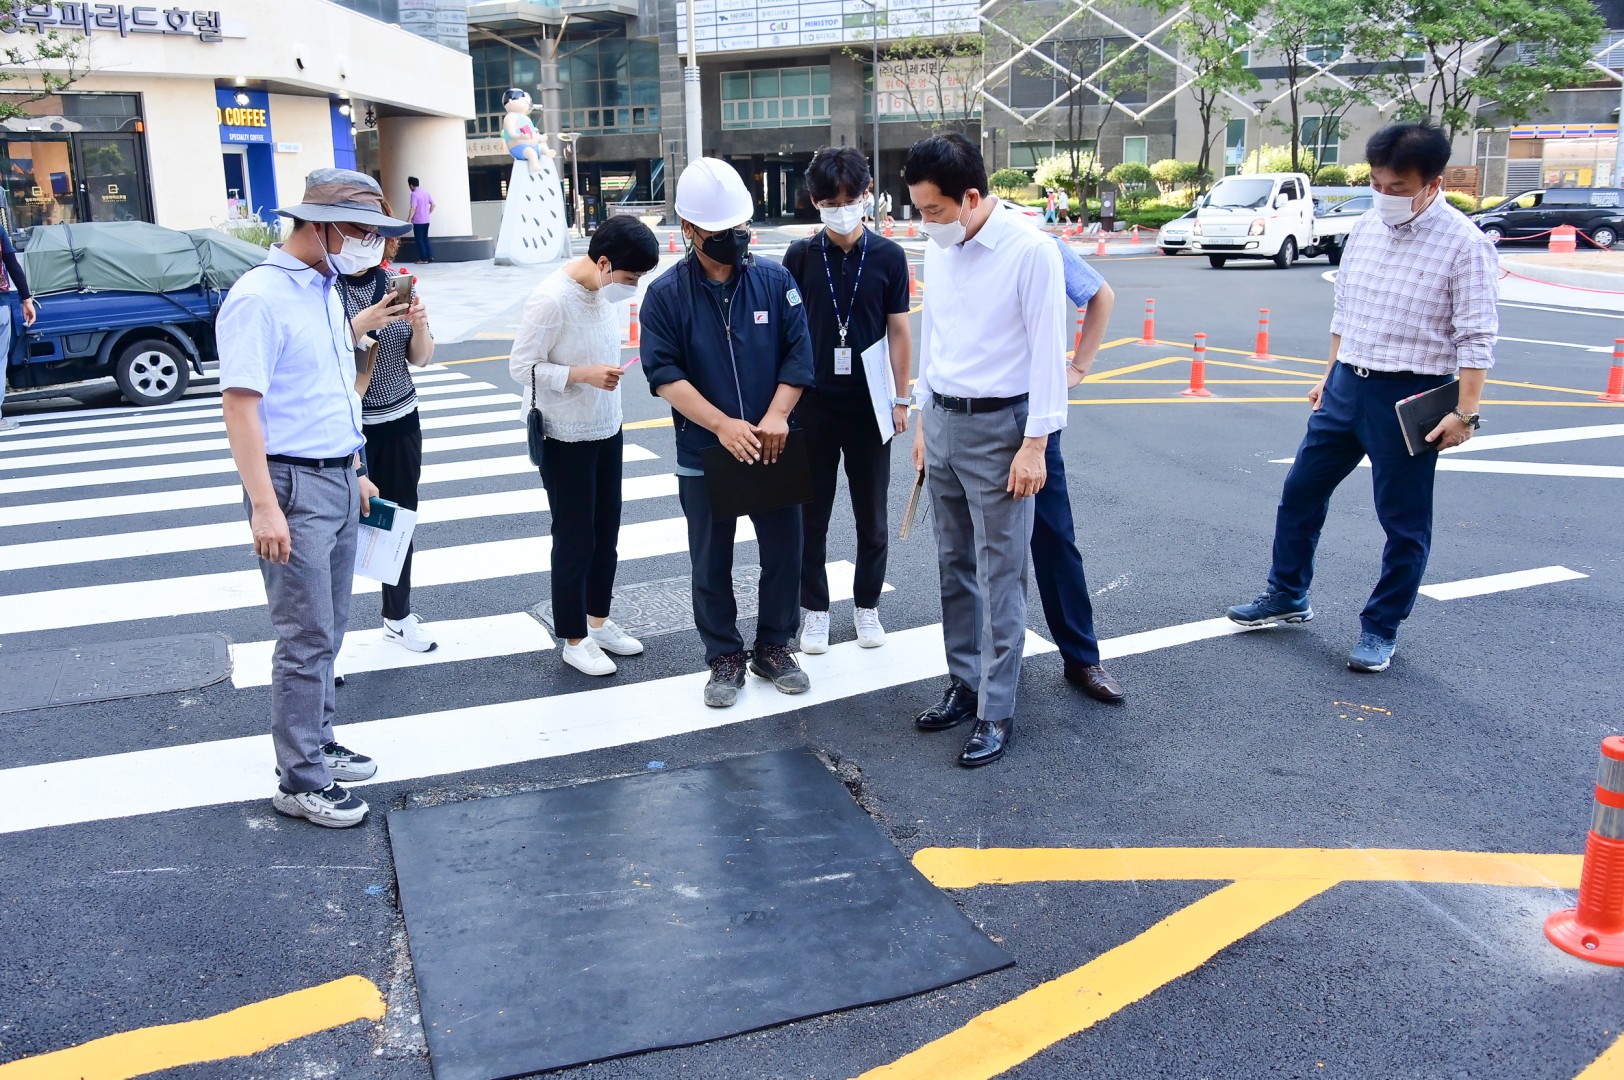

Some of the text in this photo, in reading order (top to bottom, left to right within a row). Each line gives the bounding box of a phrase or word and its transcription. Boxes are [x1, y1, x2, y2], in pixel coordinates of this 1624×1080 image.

[804, 19, 839, 28] MINISTOP
[224, 107, 267, 127] COFFEE
[229, 133, 249, 141] SPECIALTY
[306, 799, 317, 807] FILA
